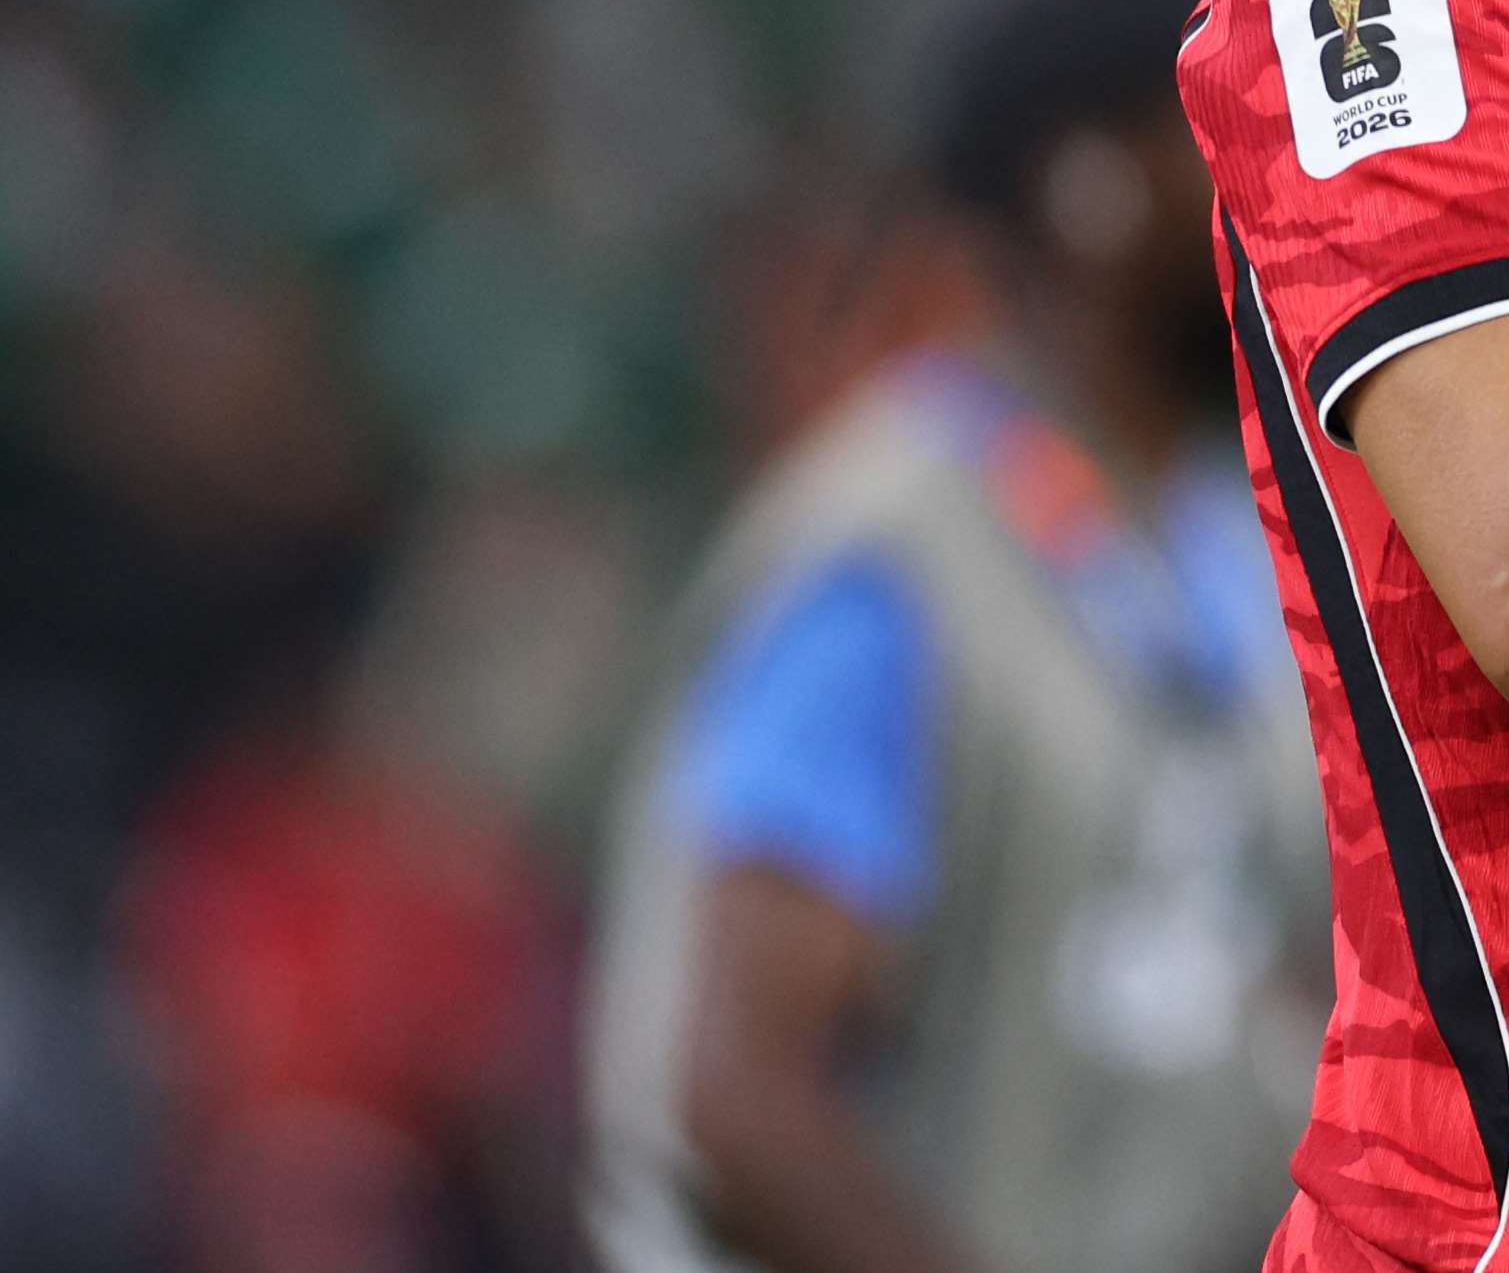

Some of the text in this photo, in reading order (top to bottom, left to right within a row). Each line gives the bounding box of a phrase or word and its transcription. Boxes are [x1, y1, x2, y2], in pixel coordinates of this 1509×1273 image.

[1342, 63, 1380, 89] FIFA
[1333, 93, 1407, 126] WORLD CUP
[1337, 109, 1412, 149] 2026
